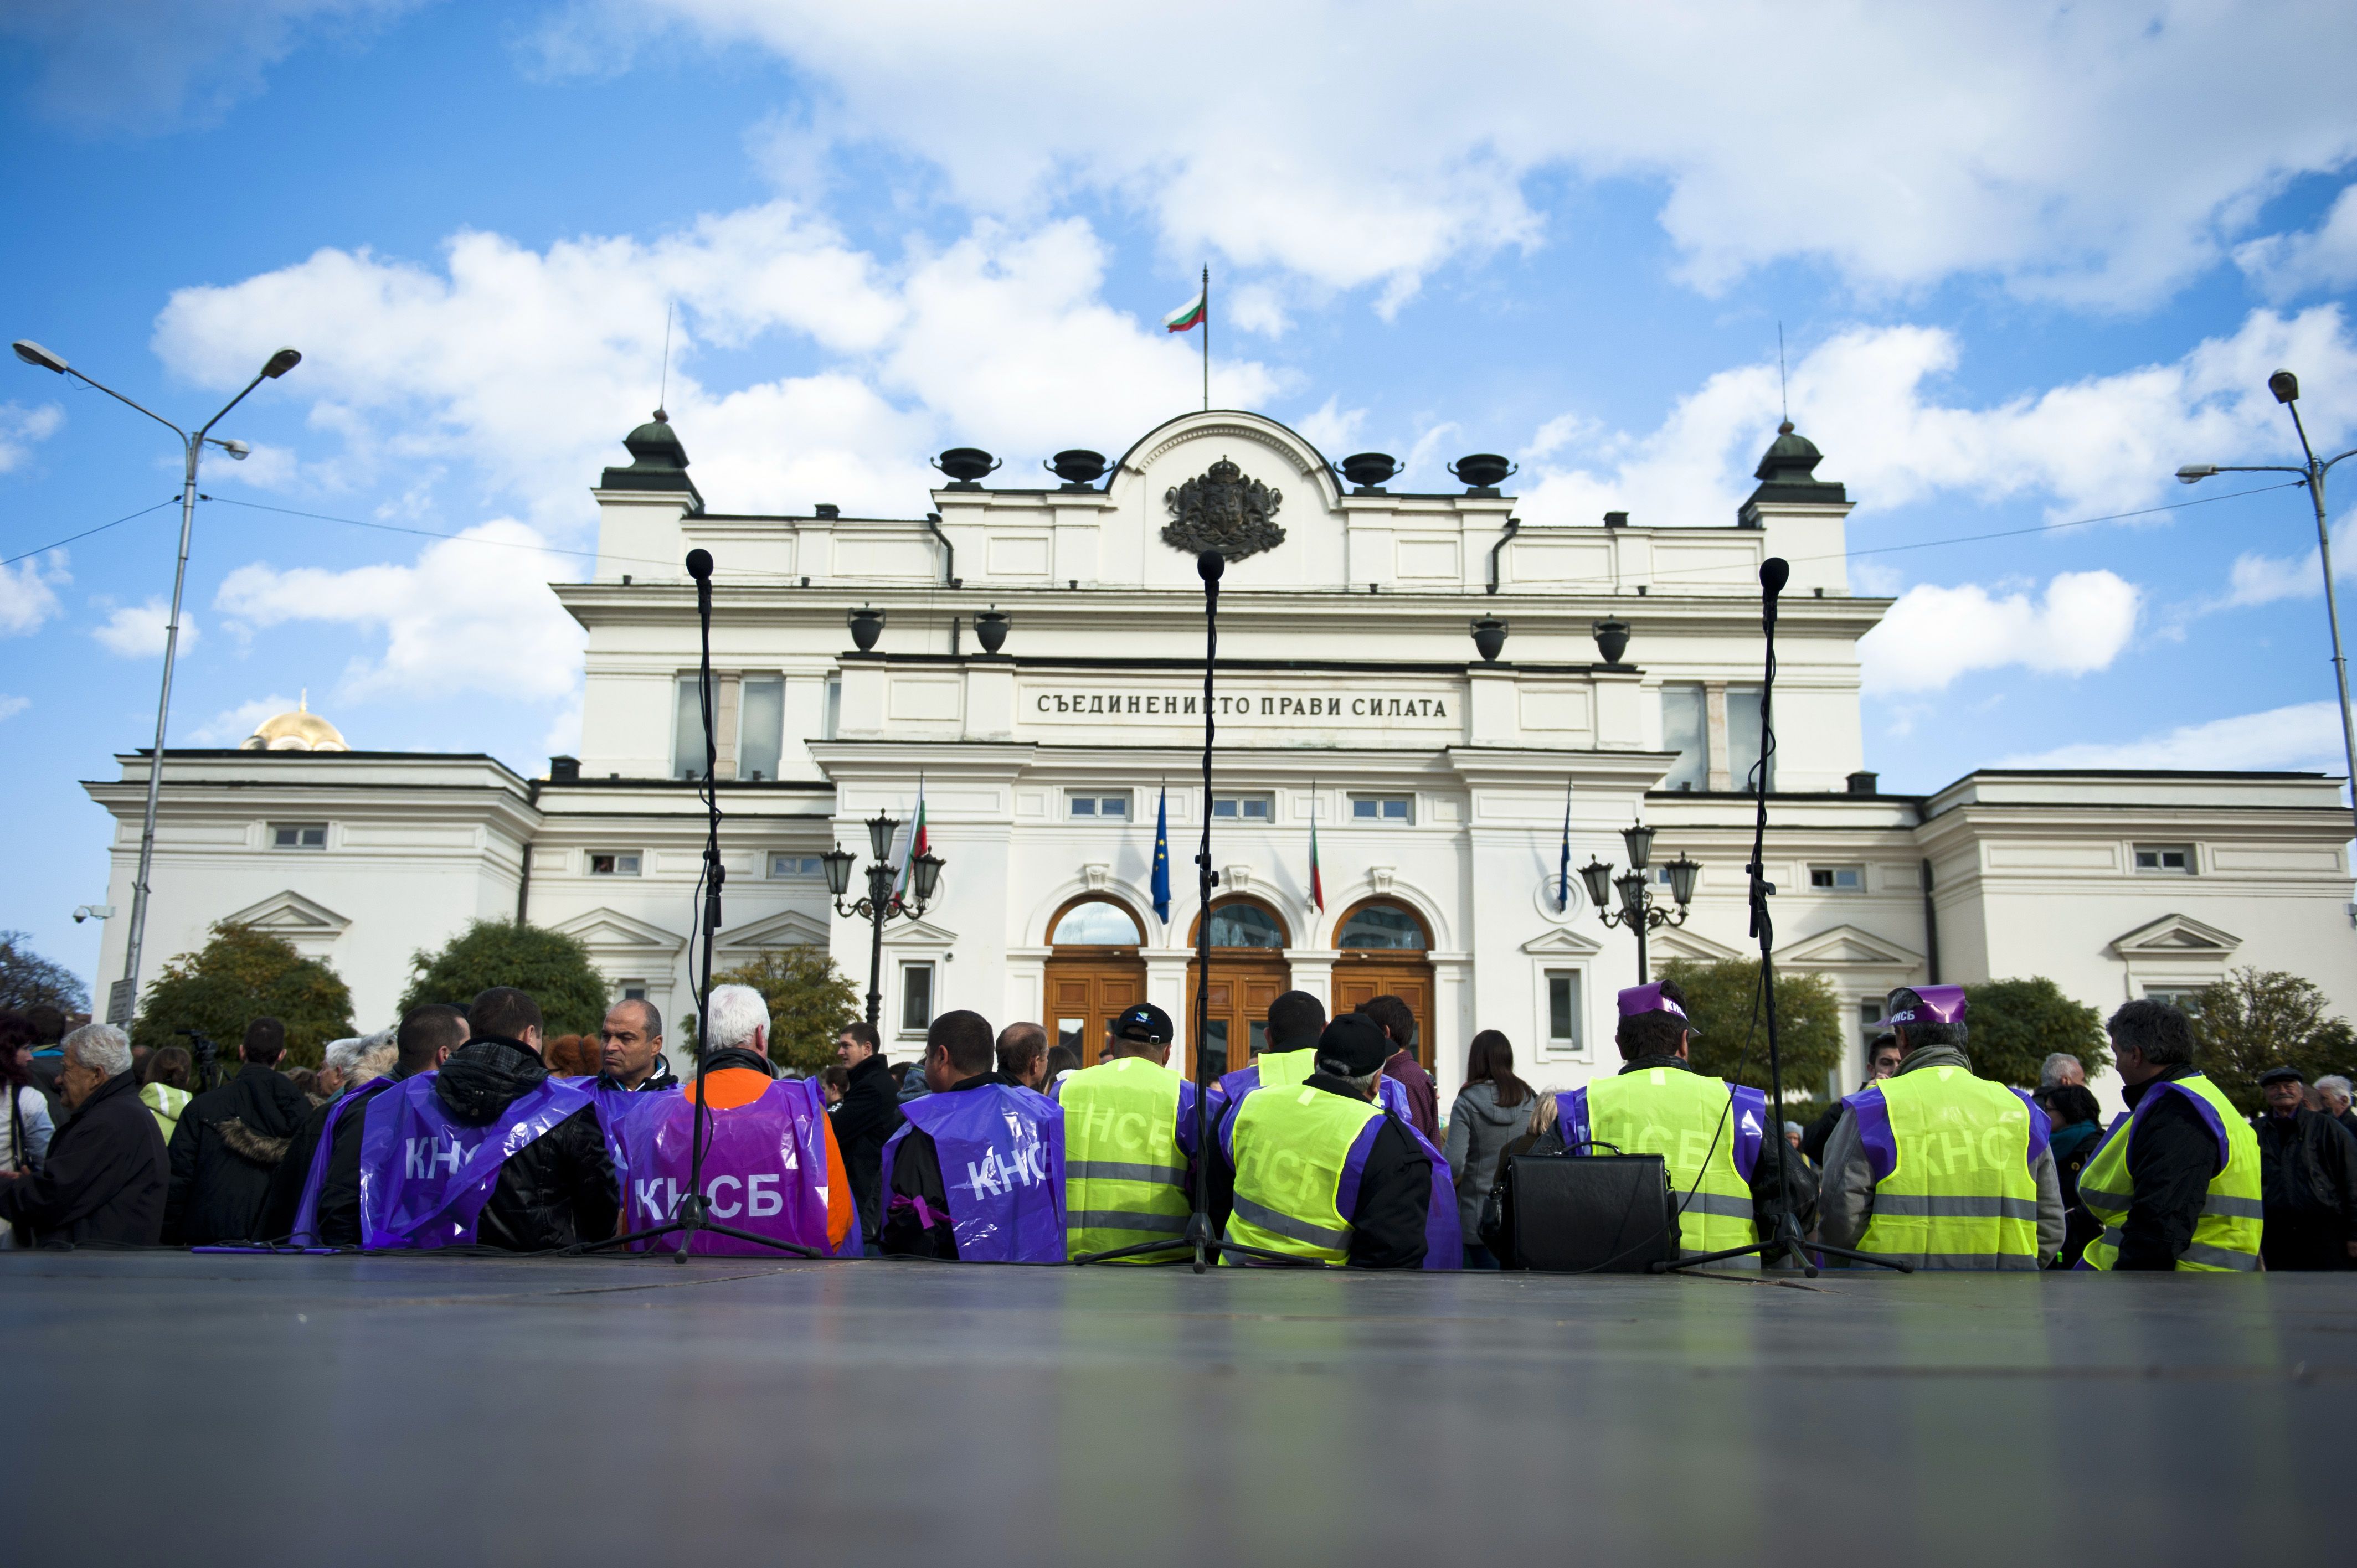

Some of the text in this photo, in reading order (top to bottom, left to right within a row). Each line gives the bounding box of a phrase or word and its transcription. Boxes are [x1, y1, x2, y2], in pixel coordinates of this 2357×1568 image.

[1037, 695, 1447, 718] СЪЕДИНЕНИЕТО ПРАВИ СИЛАТА
[1064, 1101, 1172, 1158] НСБ
[406, 1136, 483, 1179] КН
